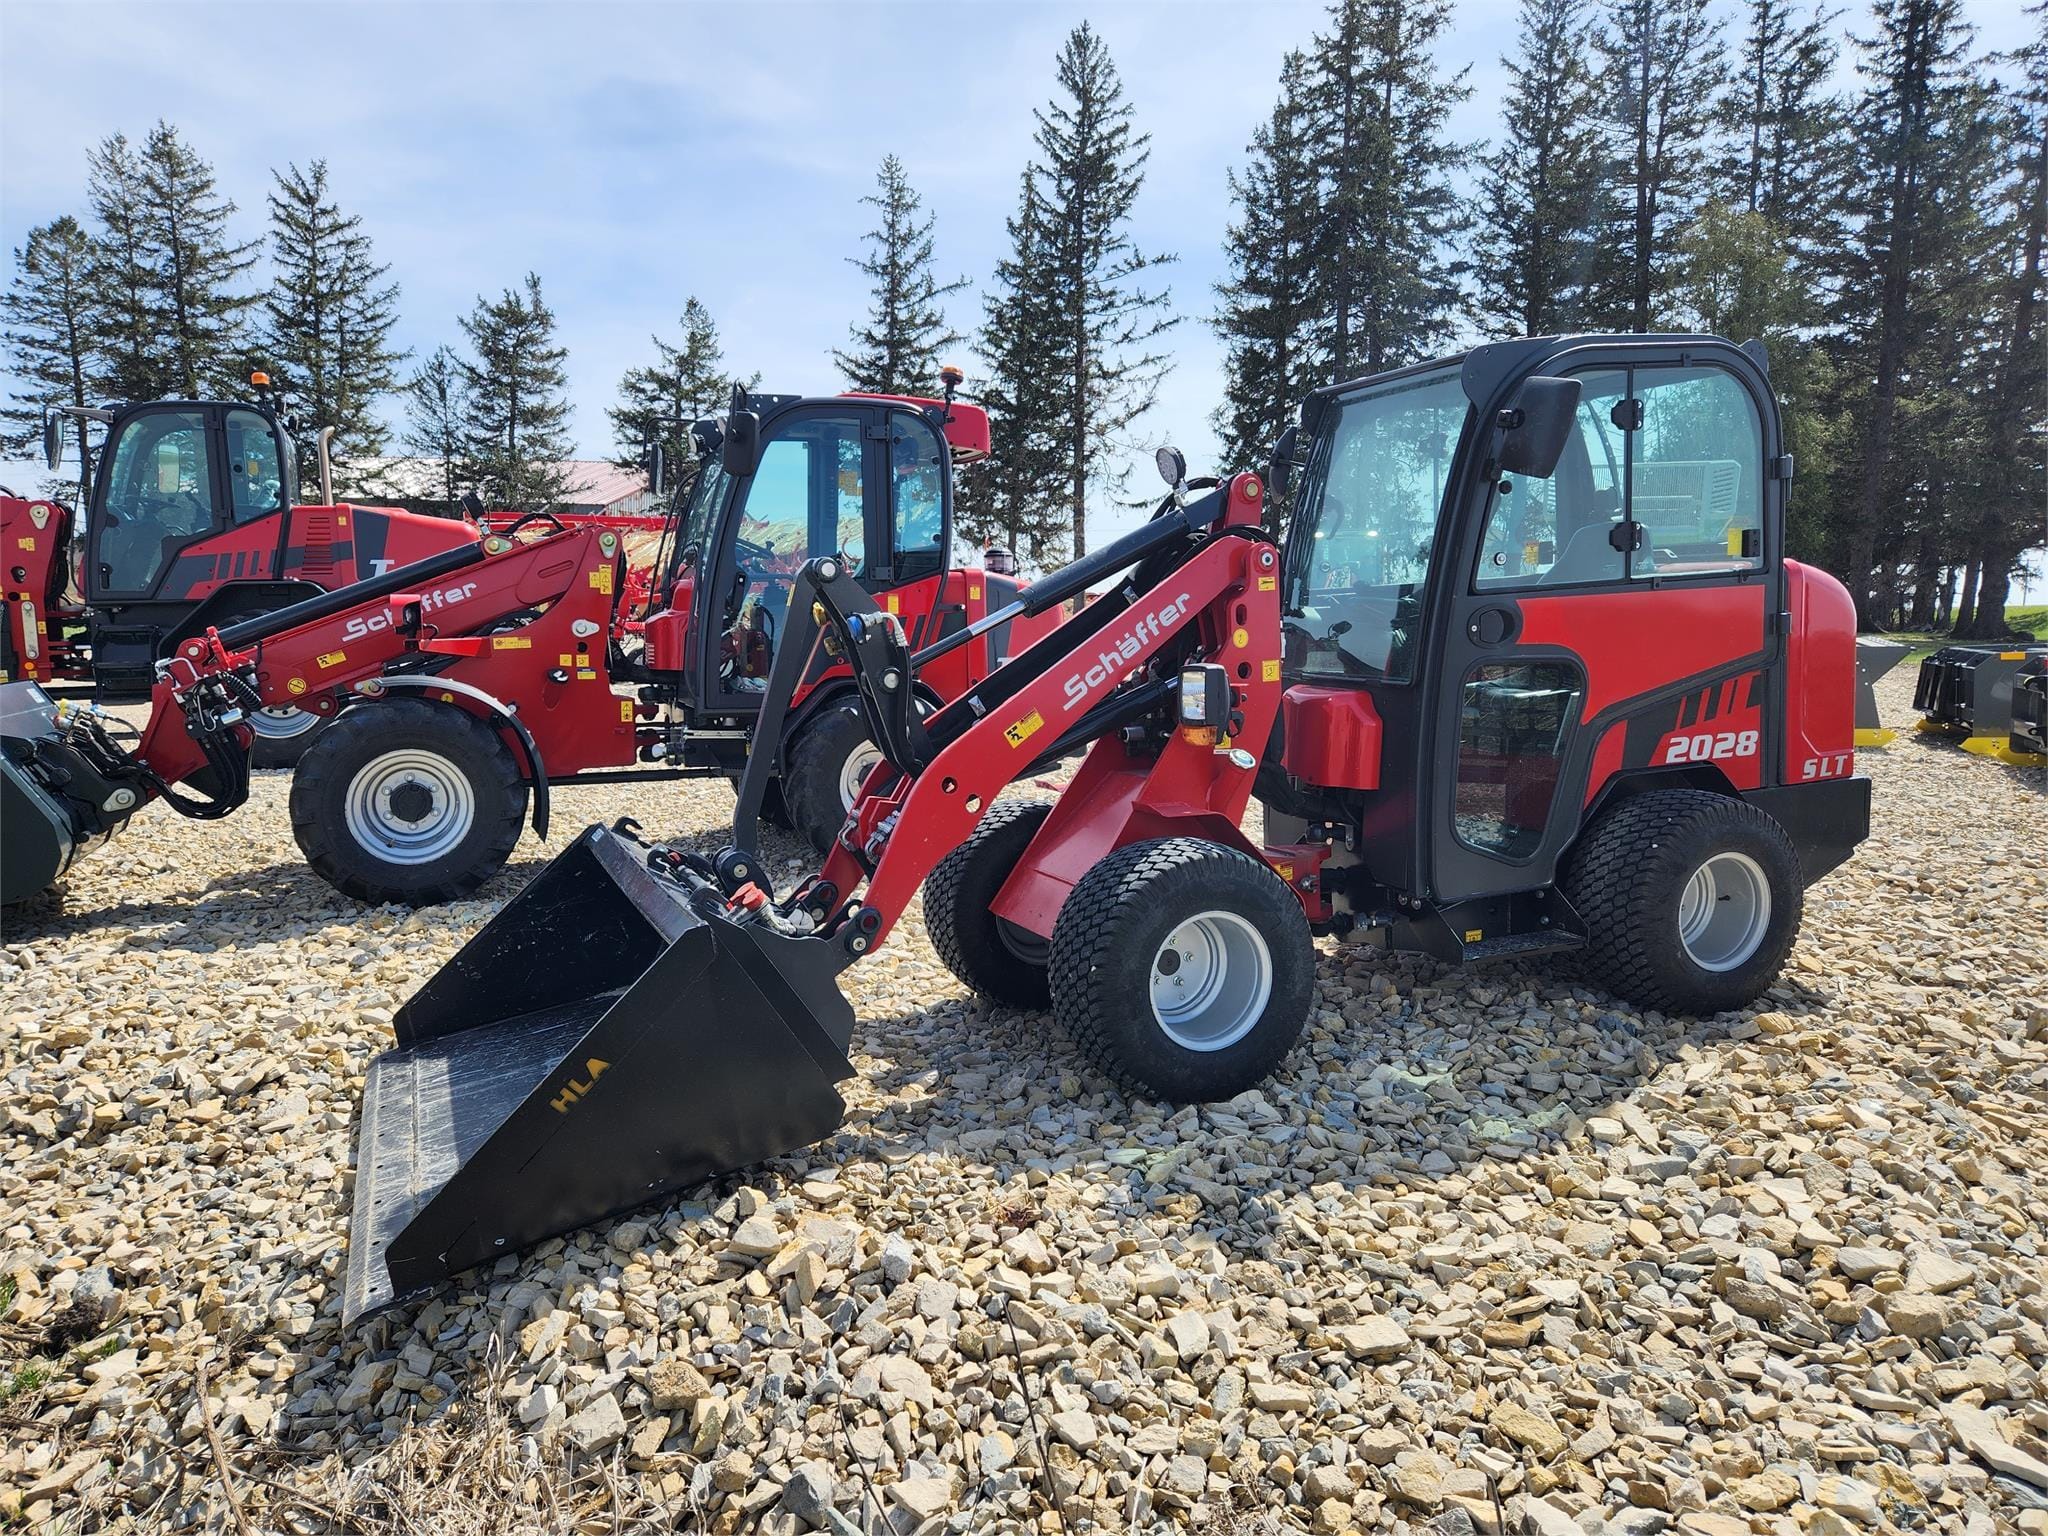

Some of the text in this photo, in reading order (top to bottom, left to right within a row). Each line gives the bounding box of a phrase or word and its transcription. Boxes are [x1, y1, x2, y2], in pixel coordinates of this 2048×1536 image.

[341, 582, 478, 642] Schffer
[1063, 593, 1191, 711] Schäffer
[1665, 730, 1759, 764] 2028
[1802, 755, 1848, 780] SLT
[550, 1058, 612, 1114] HLA
